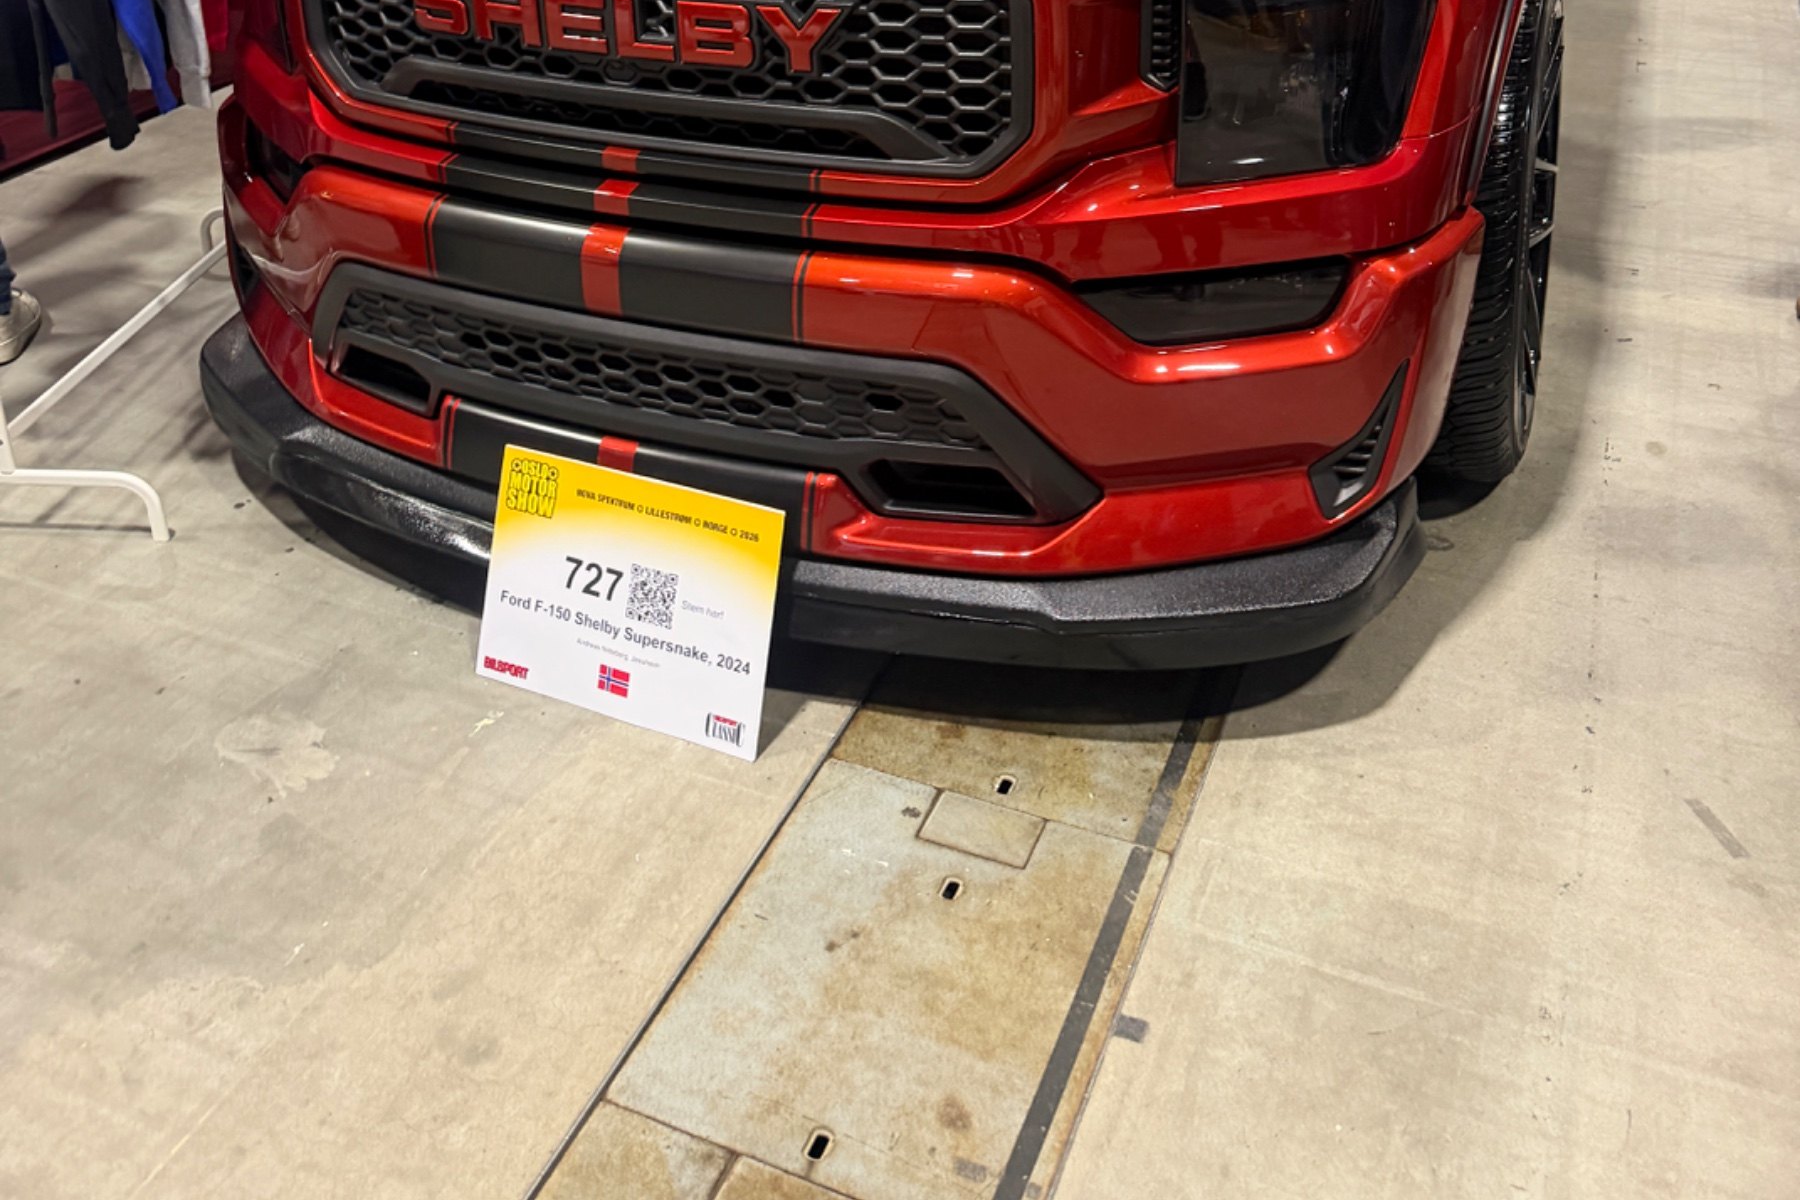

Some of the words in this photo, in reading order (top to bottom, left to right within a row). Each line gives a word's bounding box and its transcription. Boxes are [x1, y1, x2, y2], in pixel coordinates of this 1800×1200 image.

[509, 470, 557, 499] MOTOR
[520, 459, 550, 480] OSLO
[506, 487, 555, 518] SHOW
[597, 493, 635, 510] SPEKTRUM
[645, 506, 692, 524] LILLESTRØM
[702, 520, 728, 534] NORGE
[565, 555, 624, 601] 727
[500, 590, 531, 610] Ford
[534, 600, 572, 622] F-150
[574, 611, 621, 640] Shelby
[624, 627, 713, 666] Supersnake,
[716, 653, 751, 676] 2024
